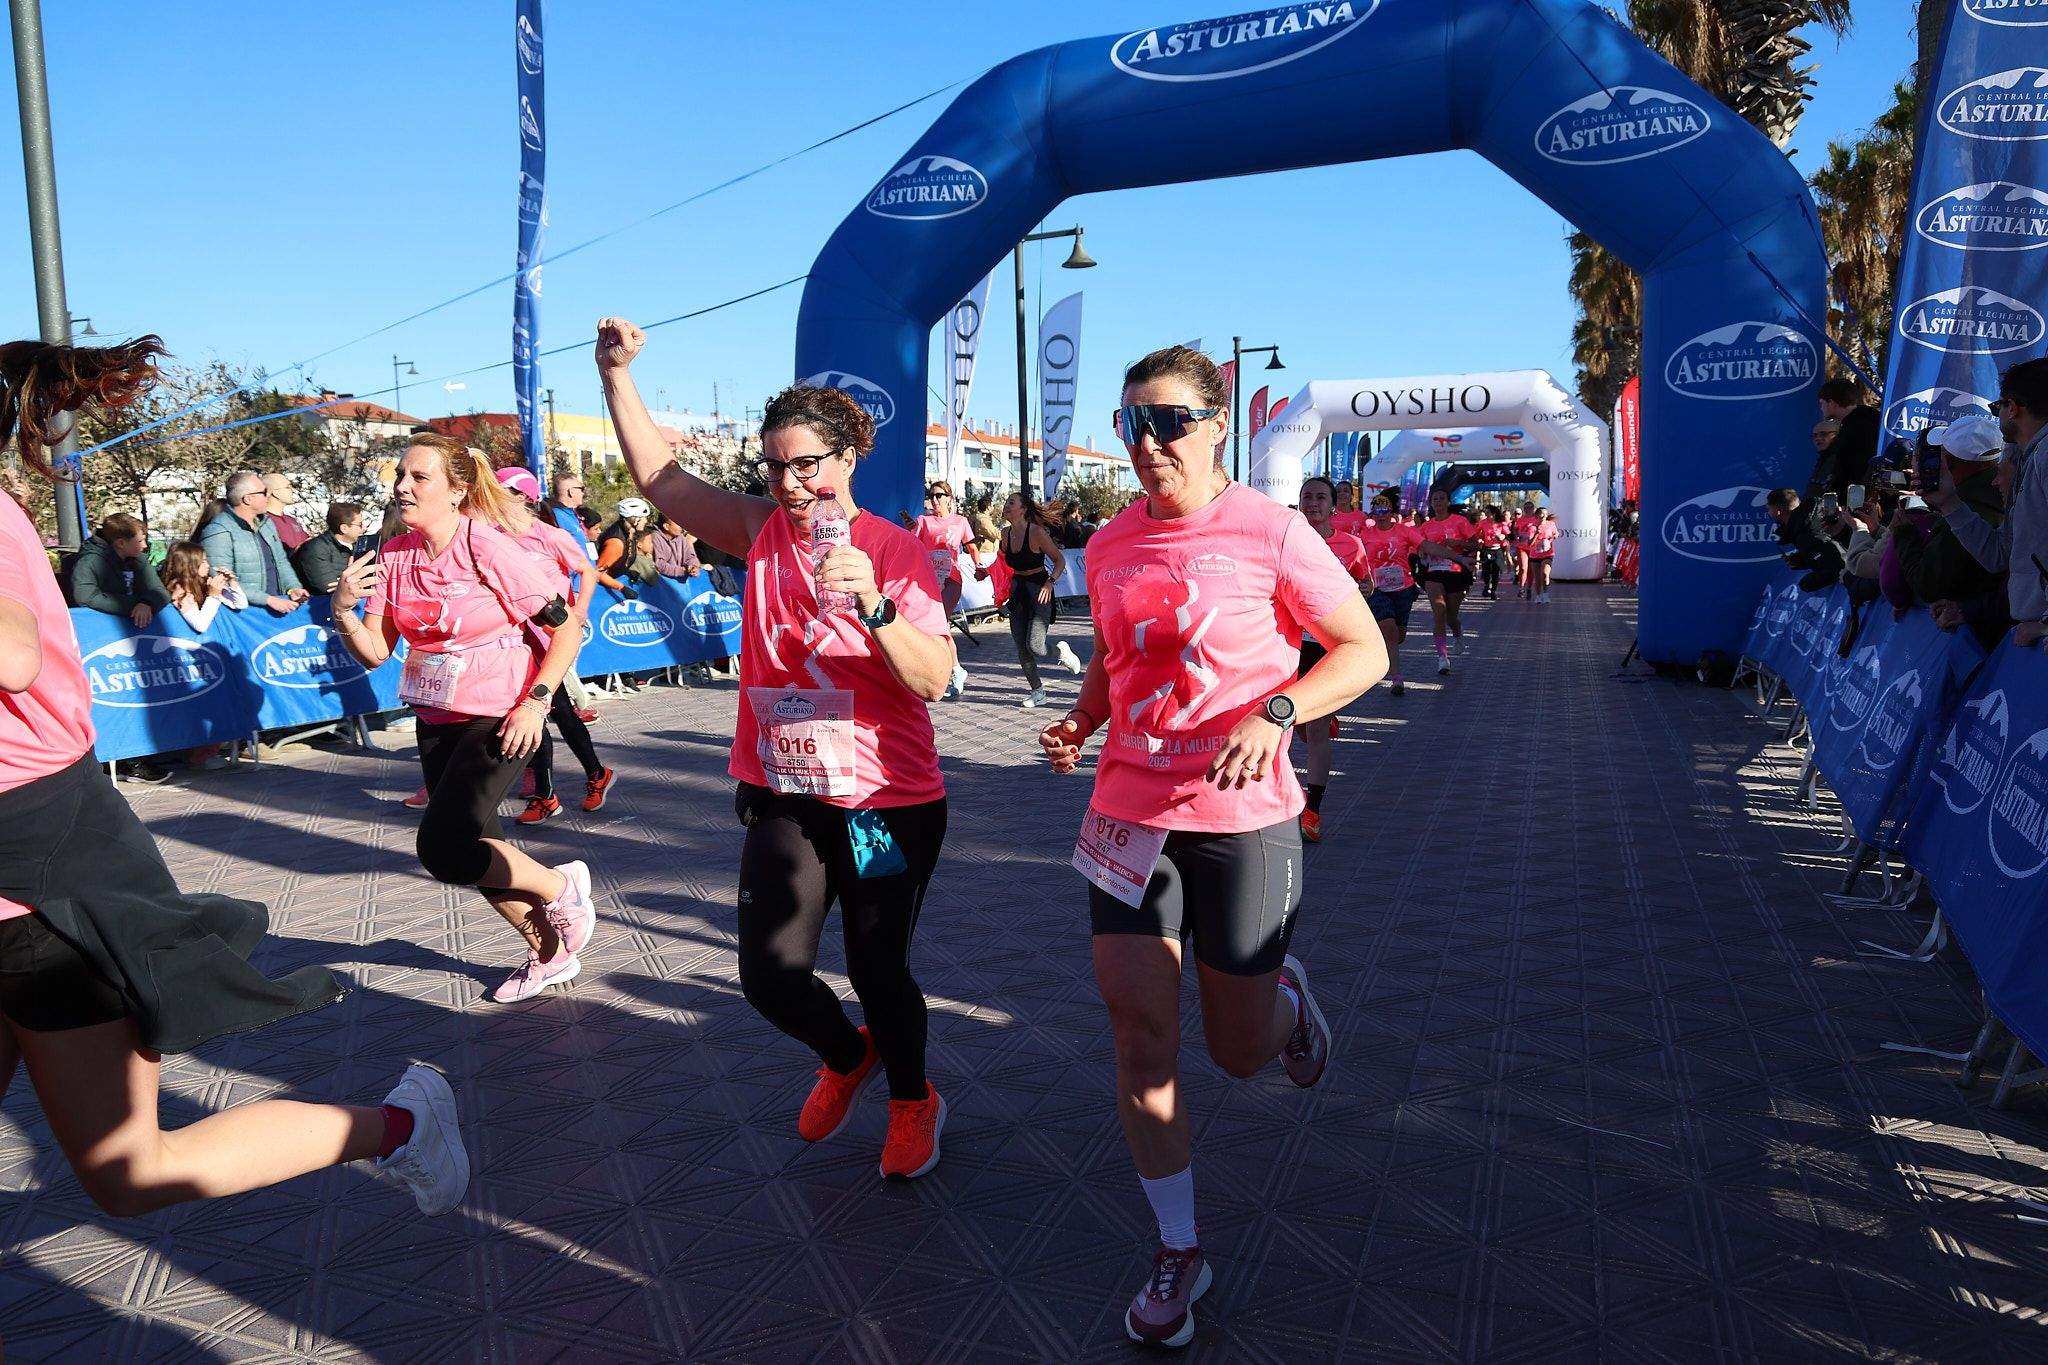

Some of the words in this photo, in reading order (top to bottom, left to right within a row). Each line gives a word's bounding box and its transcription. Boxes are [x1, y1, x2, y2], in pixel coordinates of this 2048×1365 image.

[1127, 1, 1357, 65] ASTURIANA
[1977, 93, 2031, 102] CENTRAL
[1572, 112, 1627, 128] CENTRA
[1635, 106, 1691, 117] LECHERA
[1946, 95, 2048, 123] ASTURI
[1548, 115, 1701, 154] ASTURIANA
[870, 183, 978, 208] ASTURIANA
[1952, 205, 2000, 213] CENTRAL
[2005, 206, 2048, 216] LECHE
[1926, 206, 2048, 237] ASTURIAN
[1906, 308, 2030, 342] ASTURIANA
[1934, 307, 1974, 316] CENTRAL
[1979, 310, 2029, 322] LECHERA
[1698, 347, 1755, 360] CENTRAL
[1674, 355, 1812, 385] ASTURIANA
[1350, 384, 1492, 418] OYSHO
[1533, 410, 1579, 424] OYSHO
[1271, 424, 1311, 434] OYSHO
[1628, 399, 1637, 462] Santander
[1466, 468, 1534, 478] VOLVO
[1695, 513, 1751, 521] CENTRAL
[1671, 515, 1781, 544] ASTURIA
[1102, 563, 1146, 582] OYSHO
[608, 616, 671, 637] ASTURIANA
[690, 608, 742, 629] ASTURIANA
[263, 651, 353, 678] ASTURIA
[88, 662, 219, 695] ASTURIANA
[419, 676, 442, 692] 016
[776, 703, 814, 716] ASTURIANA
[778, 737, 817, 755] 016
[1168, 739, 1181, 755] LA
[1184, 735, 1231, 754] MUJER
[1148, 755, 1172, 768] 2025
[1096, 814, 1131, 848] 016
[1113, 863, 1134, 880] VALENCIA
[1101, 874, 1130, 896] Santander
